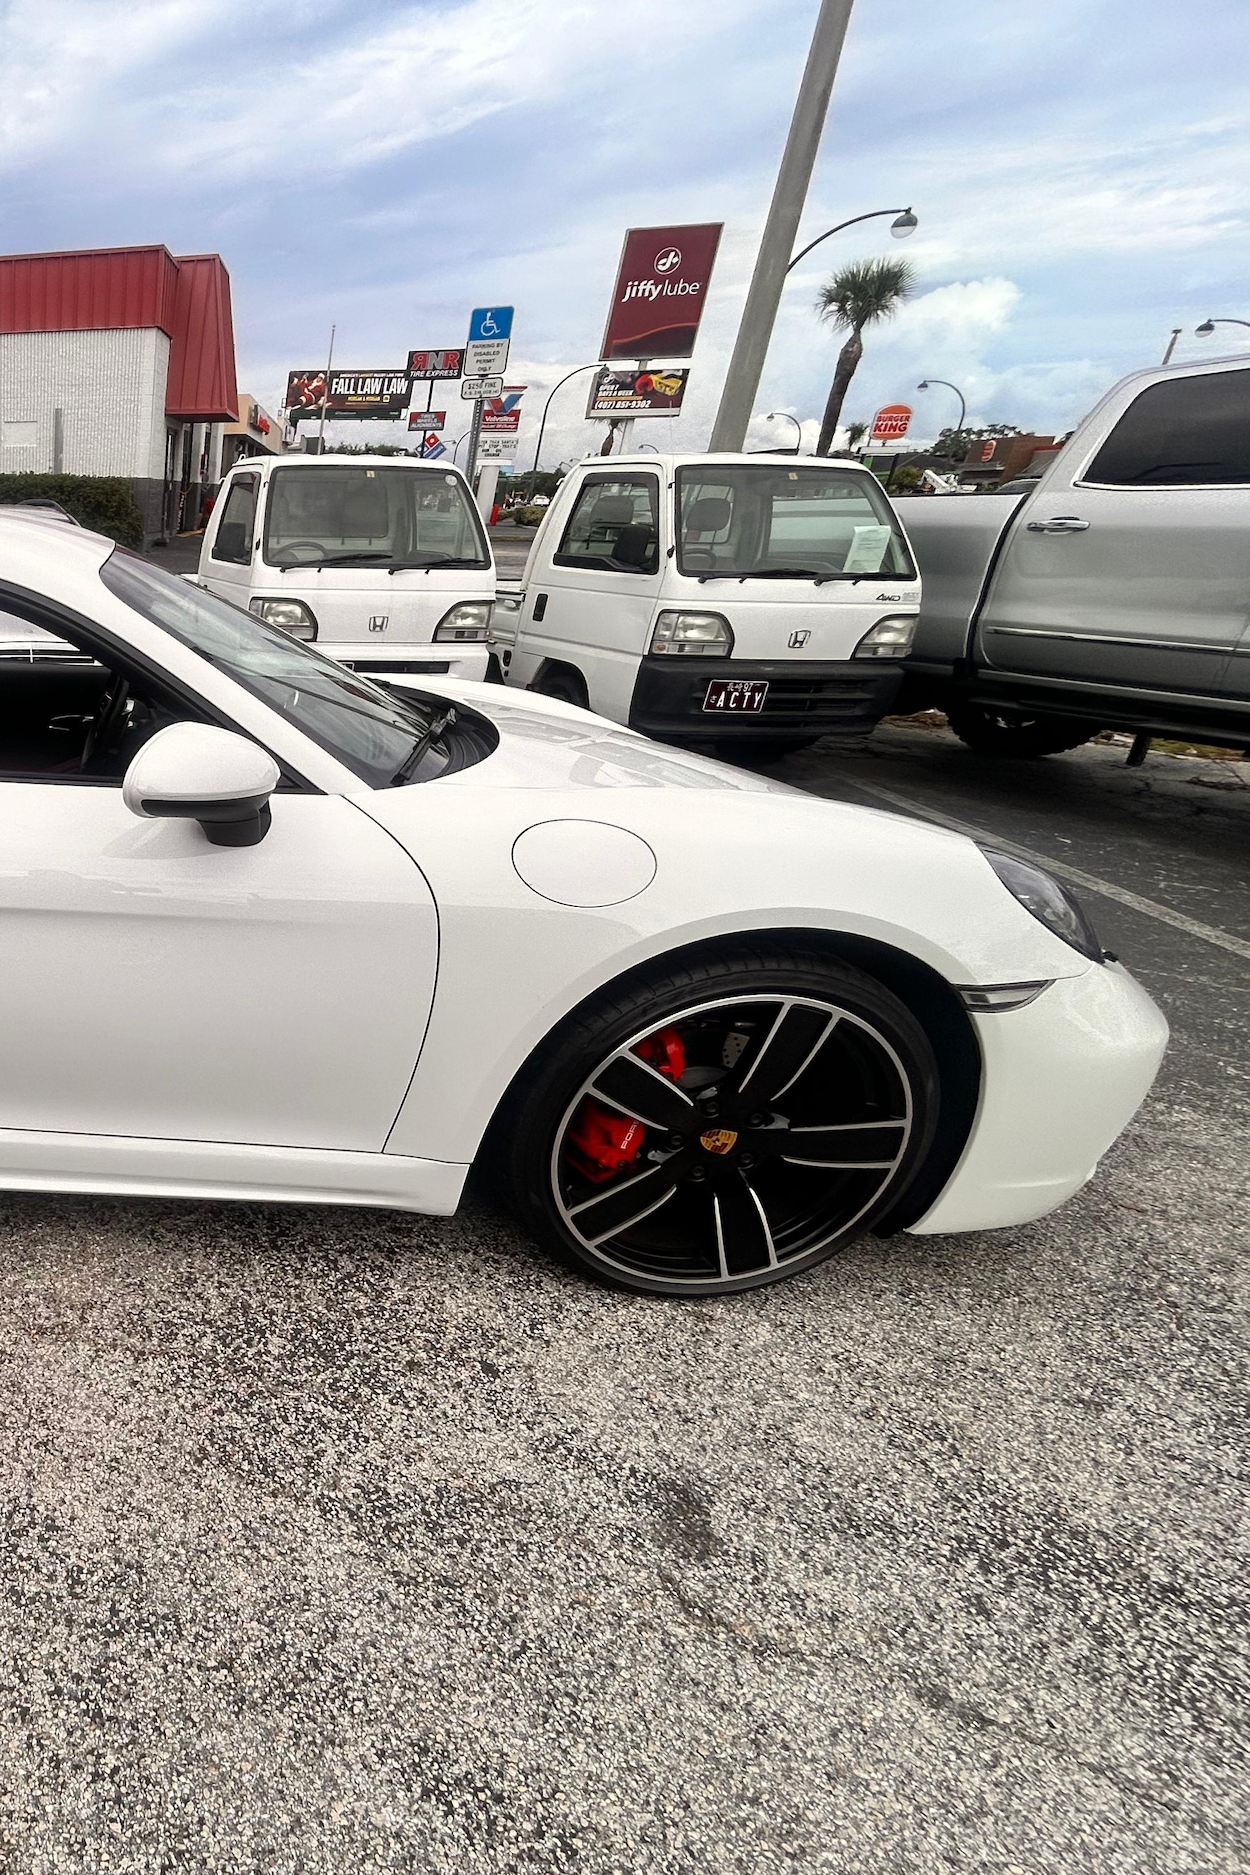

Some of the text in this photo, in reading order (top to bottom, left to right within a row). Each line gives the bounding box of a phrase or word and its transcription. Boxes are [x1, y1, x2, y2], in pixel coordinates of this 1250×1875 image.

[426, 369, 458, 377] EXPRESS
[331, 378, 409, 394] FALL LAW LAW
[594, 400, 615, 409] (407)
[873, 422, 908, 432] KING
[716, 691, 763, 708] ACTY
